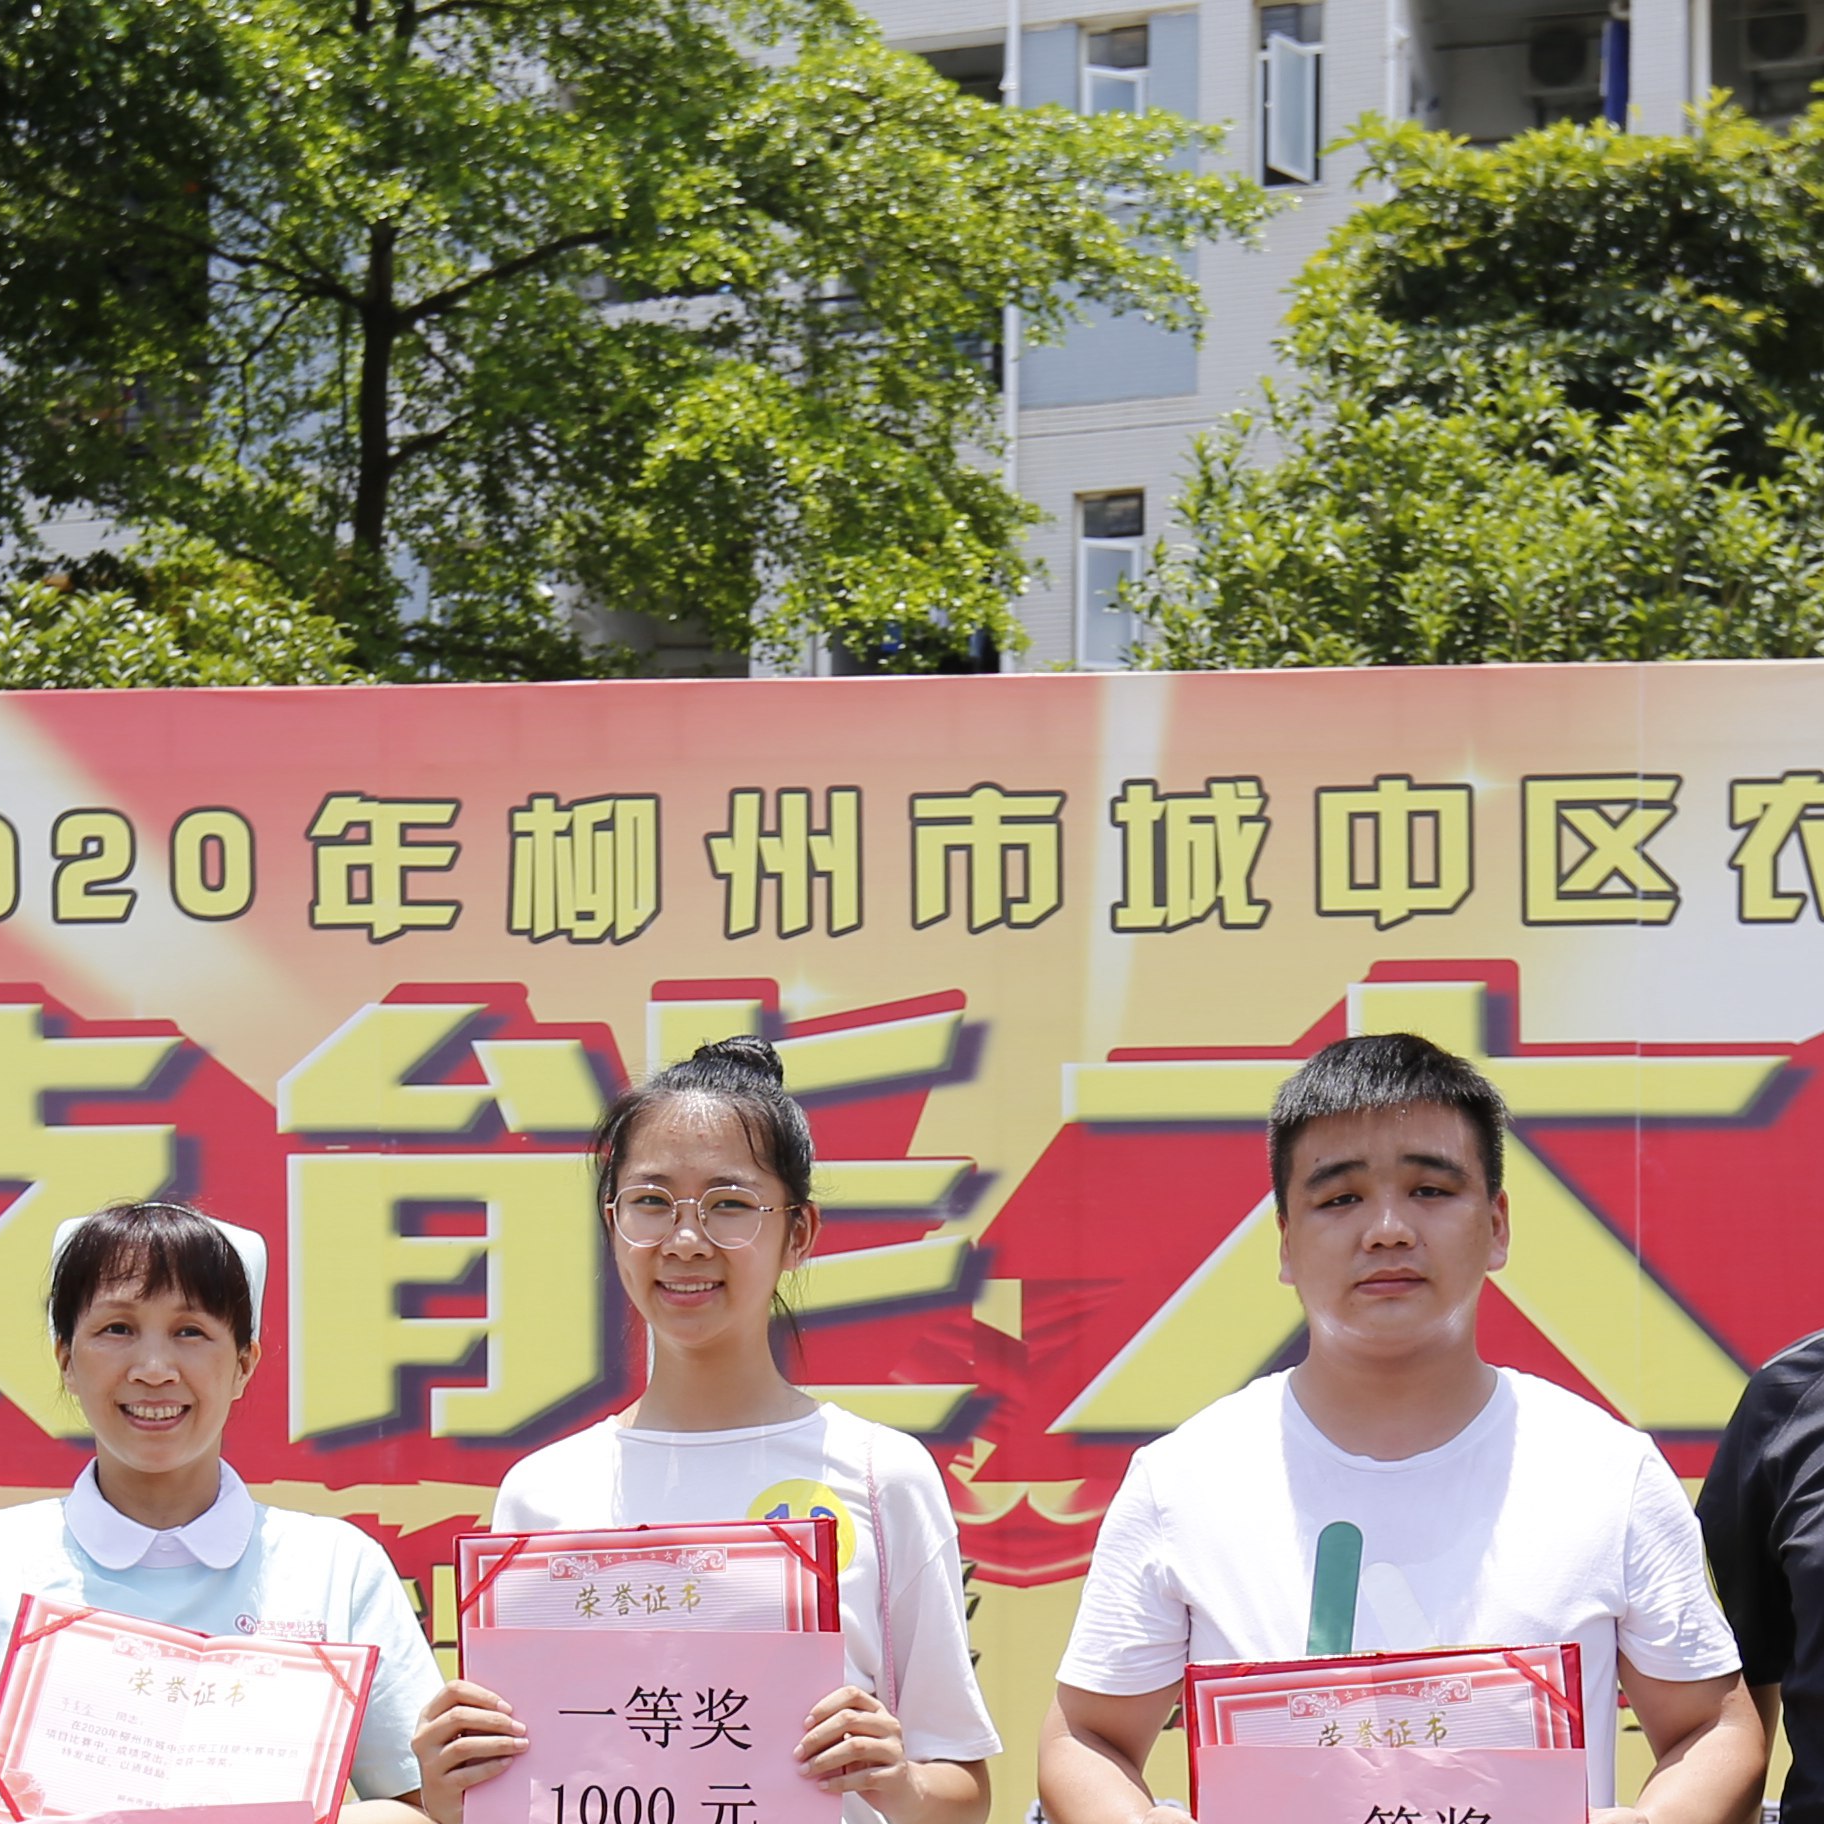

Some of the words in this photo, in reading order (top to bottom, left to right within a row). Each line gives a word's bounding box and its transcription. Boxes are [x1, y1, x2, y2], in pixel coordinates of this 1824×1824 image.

[575, 1578, 702, 1619] 荣誉证书
[128, 1667, 249, 1708] 荣誉证书
[560, 1687, 752, 1750] 一等奖
[1318, 1711, 1448, 1748] 荣誉证书
